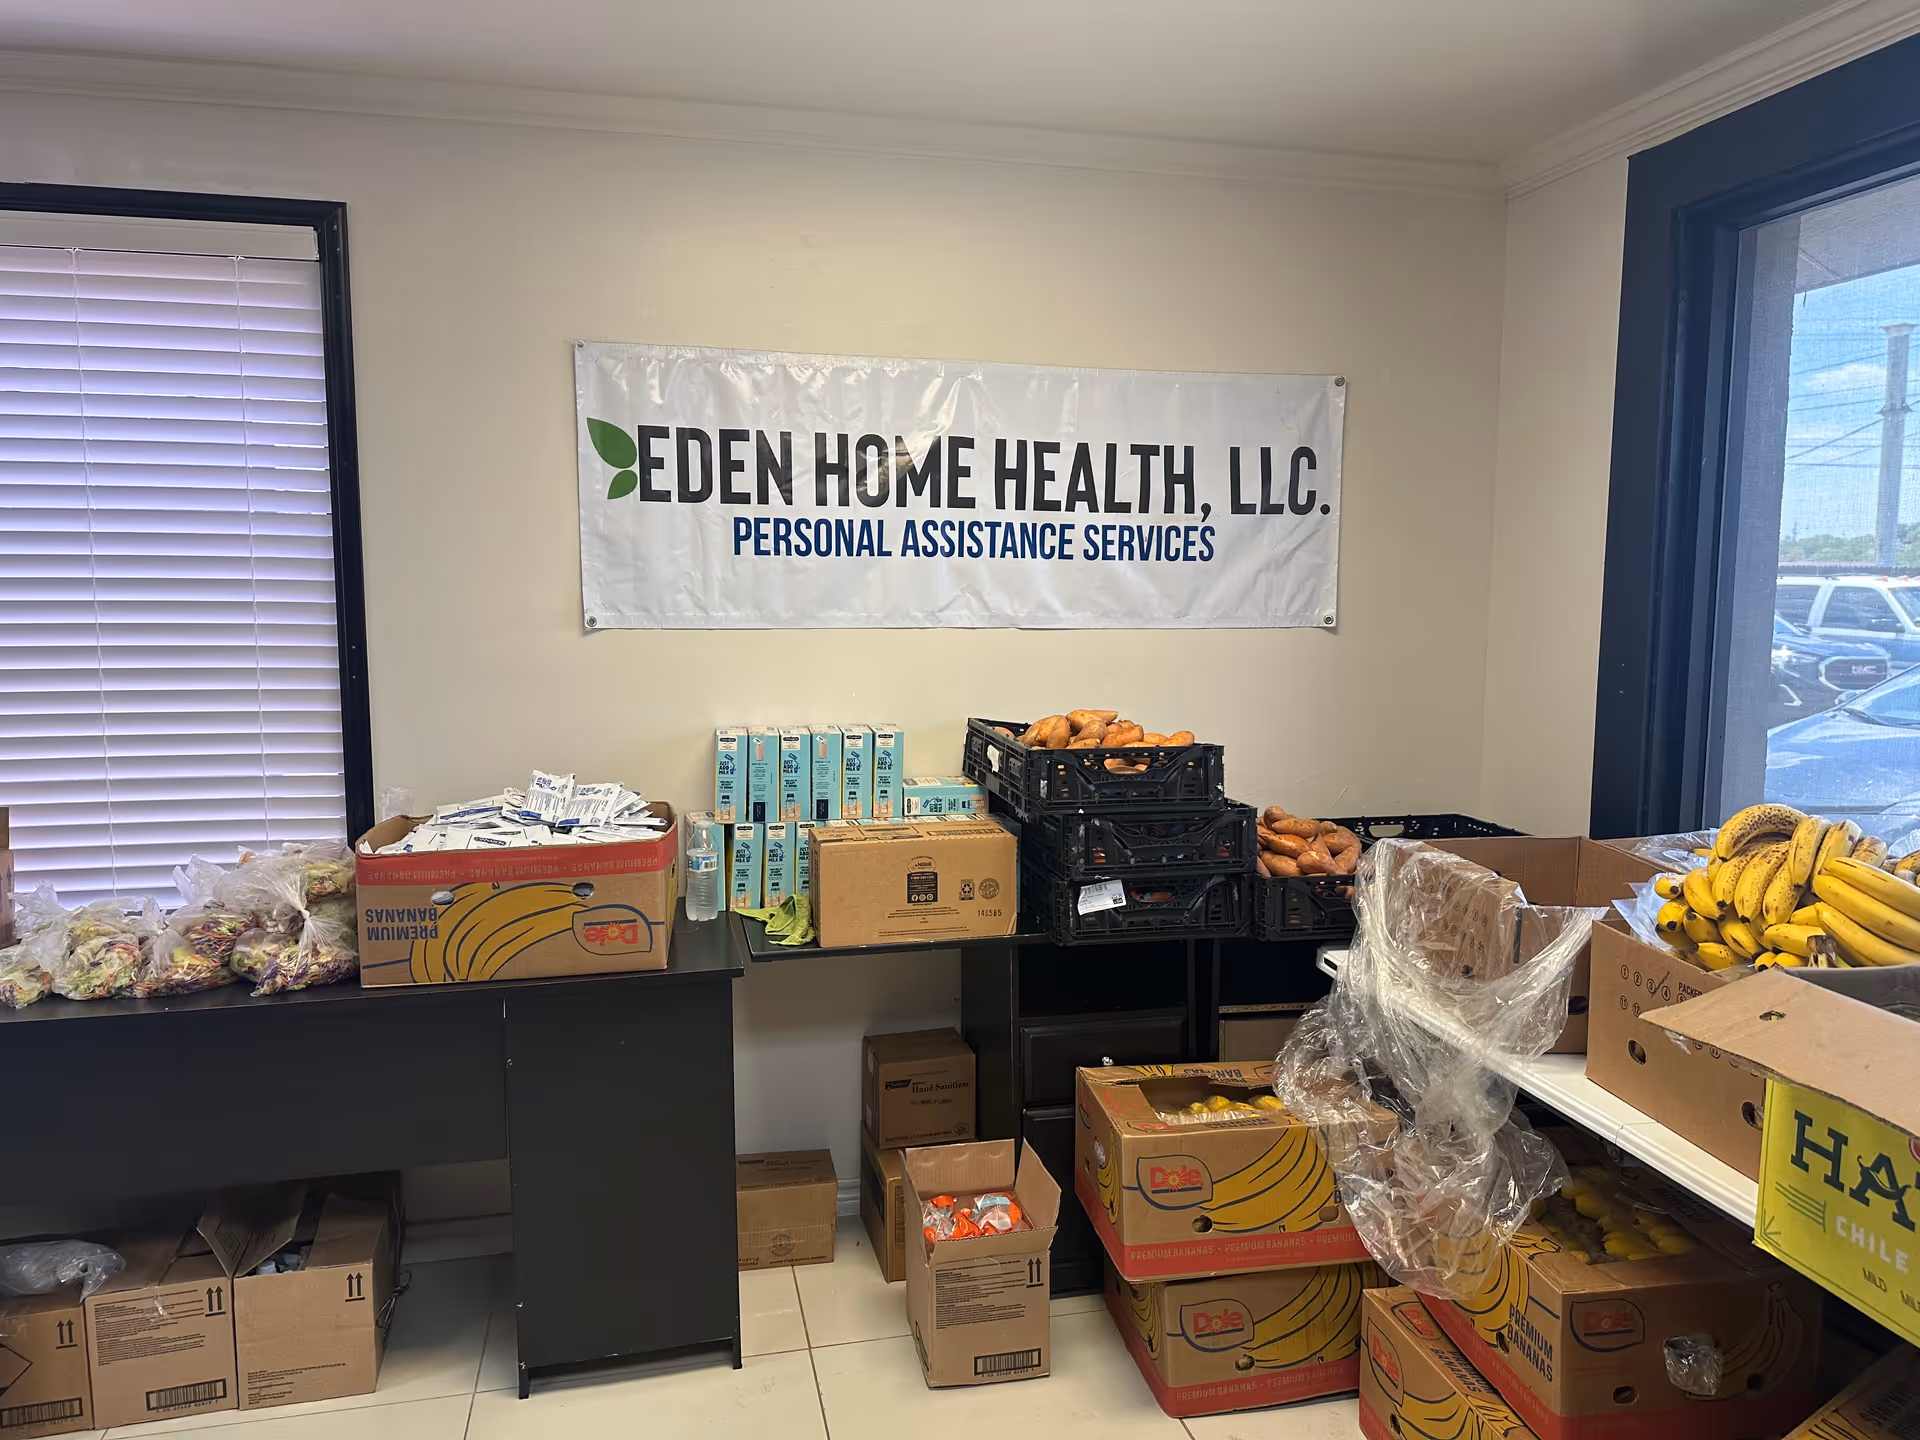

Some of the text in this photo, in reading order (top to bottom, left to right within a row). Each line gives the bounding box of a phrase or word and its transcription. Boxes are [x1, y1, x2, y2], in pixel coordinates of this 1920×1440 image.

[637, 425, 1331, 523] EDEN HOME HEALTH, LLC.
[733, 517, 1216, 562] PERSONAL ASSISTANCE SERVICES
[365, 907, 438, 923] BANANAS
[367, 924, 439, 941] PREMIUM
[583, 923, 639, 946] Dole
[912, 1084, 933, 1093] Hand
[935, 1082, 969, 1091] Sanitizer
[1150, 1163, 1203, 1190] Dole
[1791, 1109, 1920, 1232] HA
[1835, 1215, 1909, 1274] CHILE
[1863, 1268, 1888, 1293] MILD
[1193, 1309, 1244, 1333] Dole
[1509, 1301, 1553, 1361] PREMIUM
[1507, 1324, 1553, 1383] BANANAS
